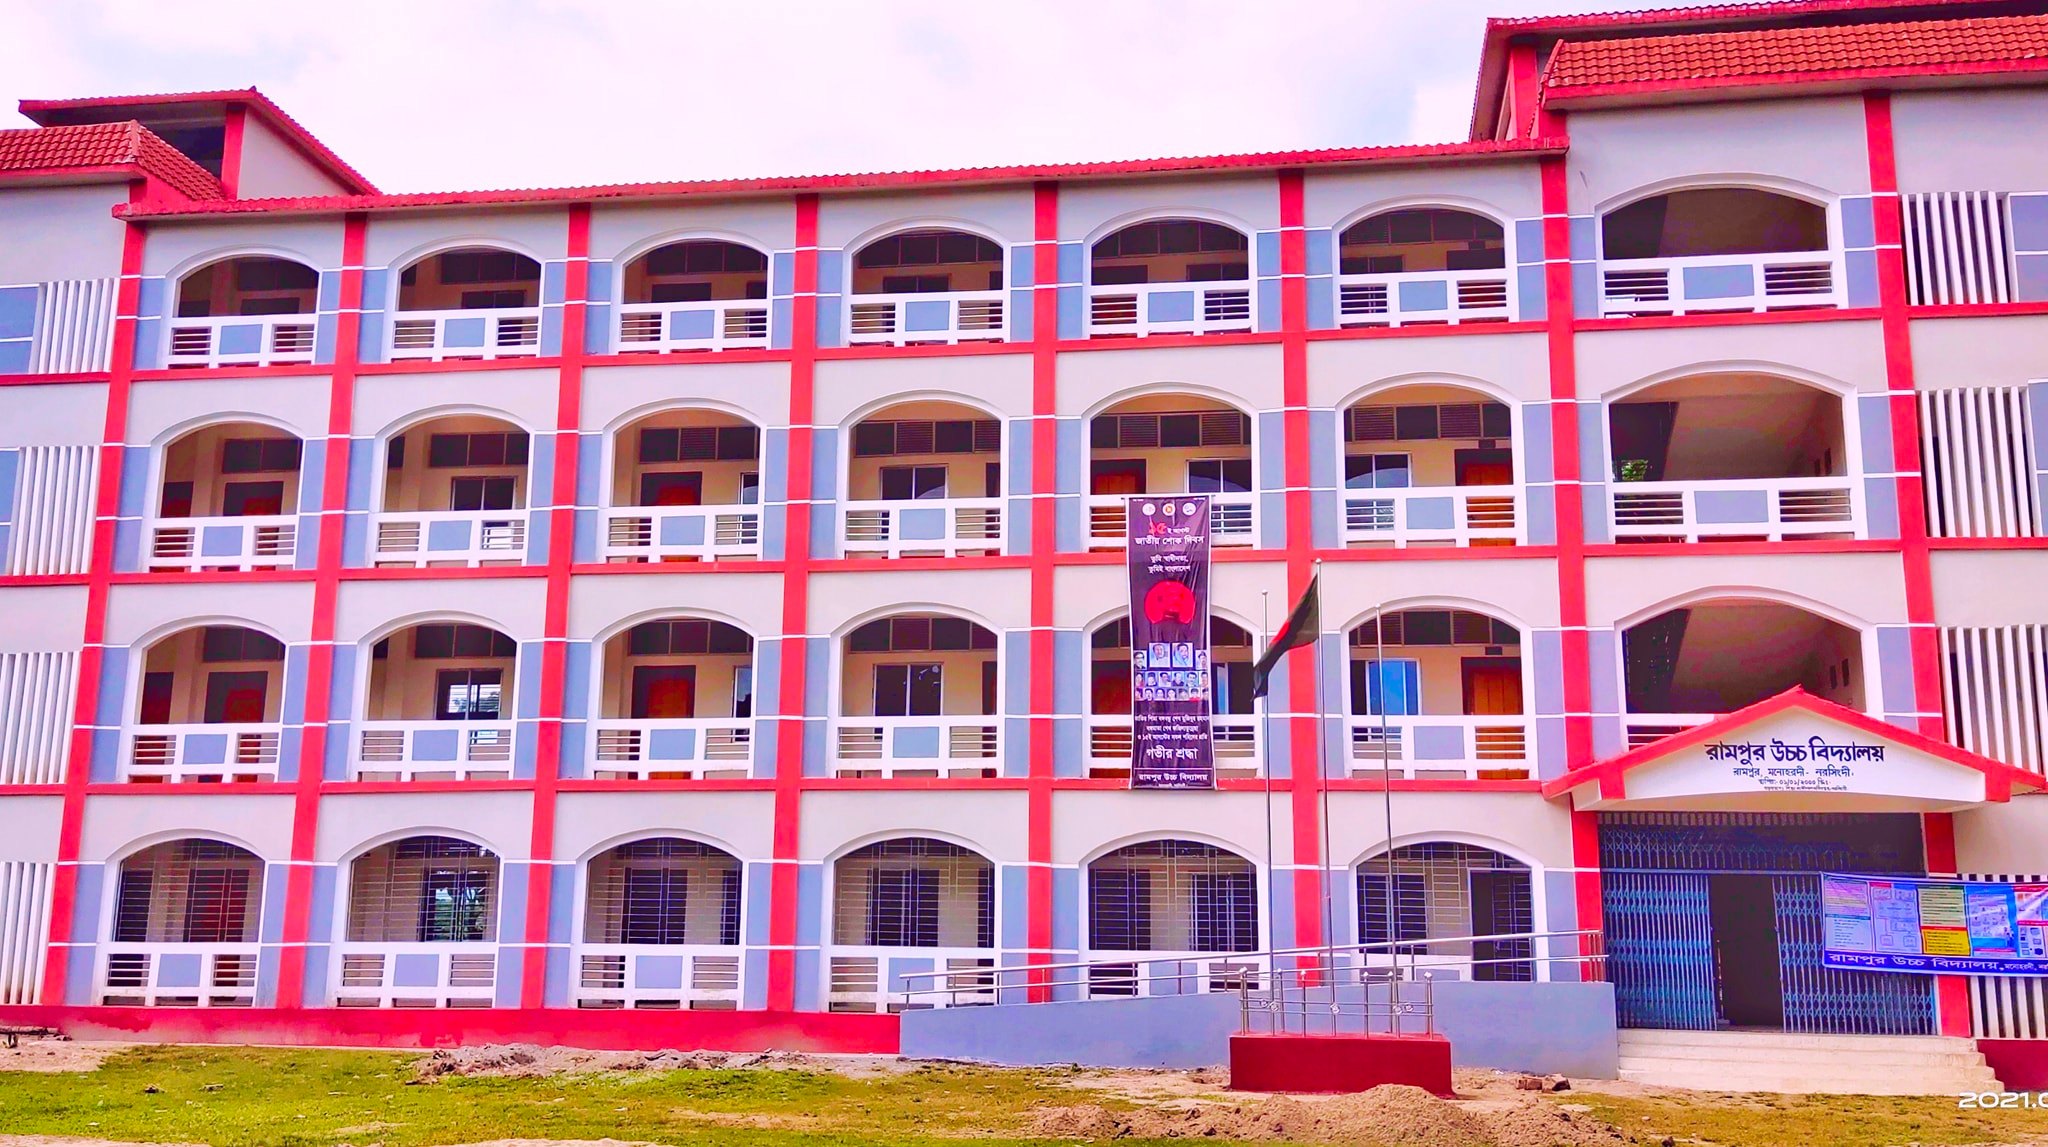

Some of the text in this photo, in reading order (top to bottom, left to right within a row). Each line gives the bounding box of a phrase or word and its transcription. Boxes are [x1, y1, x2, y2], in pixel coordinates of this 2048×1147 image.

[1134, 534, 1205, 545] জাতীয় শোক দিবস
[1164, 565, 1191, 573] বাংলাদেশ
[1146, 744, 1199, 760] গভীর শ্রদ্ধা
[1704, 735, 1885, 764] রামপুর উচ্চ বিদ্যালয়
[1138, 772, 1209, 782] রামপুর উচ্চ বিদ্যালয়
[1828, 953, 1887, 966] রামপুর
[1892, 955, 1926, 967] উচ্চ
